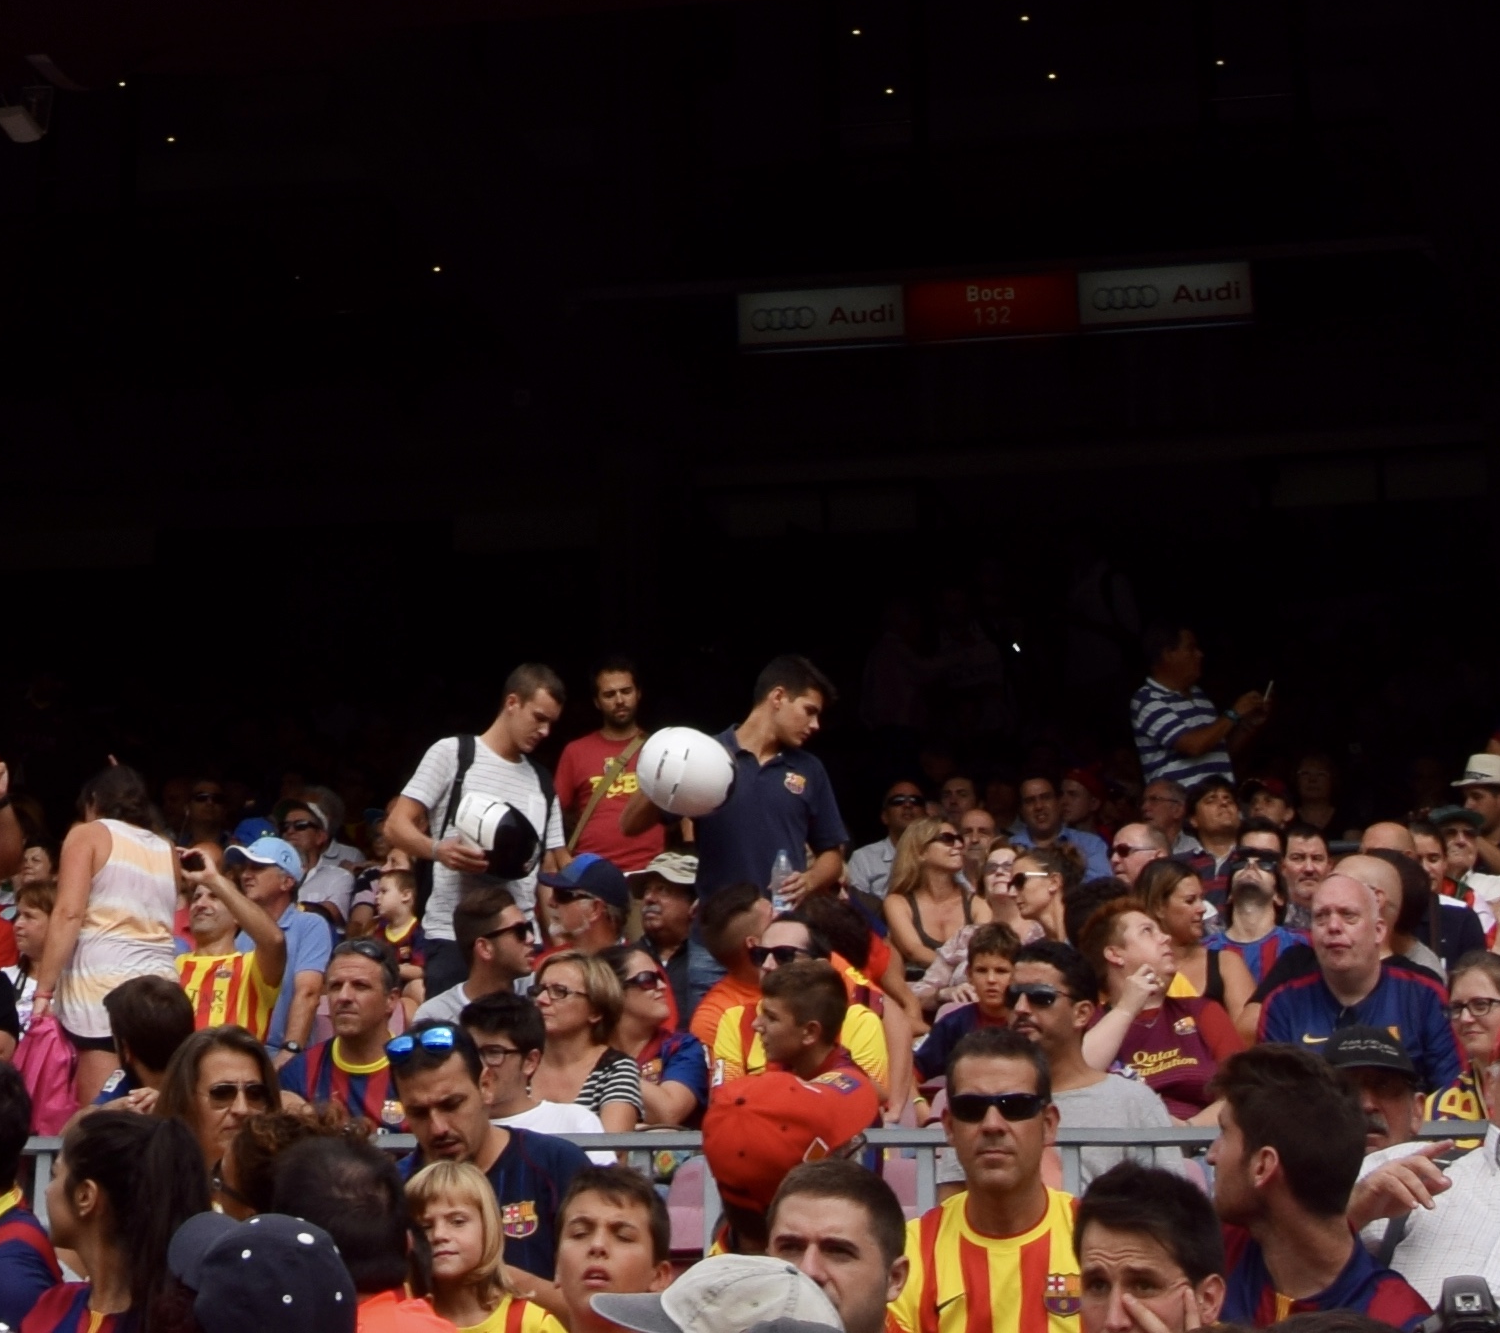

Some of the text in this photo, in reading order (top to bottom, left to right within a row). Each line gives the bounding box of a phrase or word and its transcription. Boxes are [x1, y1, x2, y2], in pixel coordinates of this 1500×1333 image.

[965, 284, 1016, 303] Boca
[1172, 278, 1241, 305] Audi
[828, 300, 895, 327] Audi
[972, 306, 1012, 326] 132
[1130, 1047, 1180, 1067] Qatar
[1136, 1055, 1198, 1077] undation
